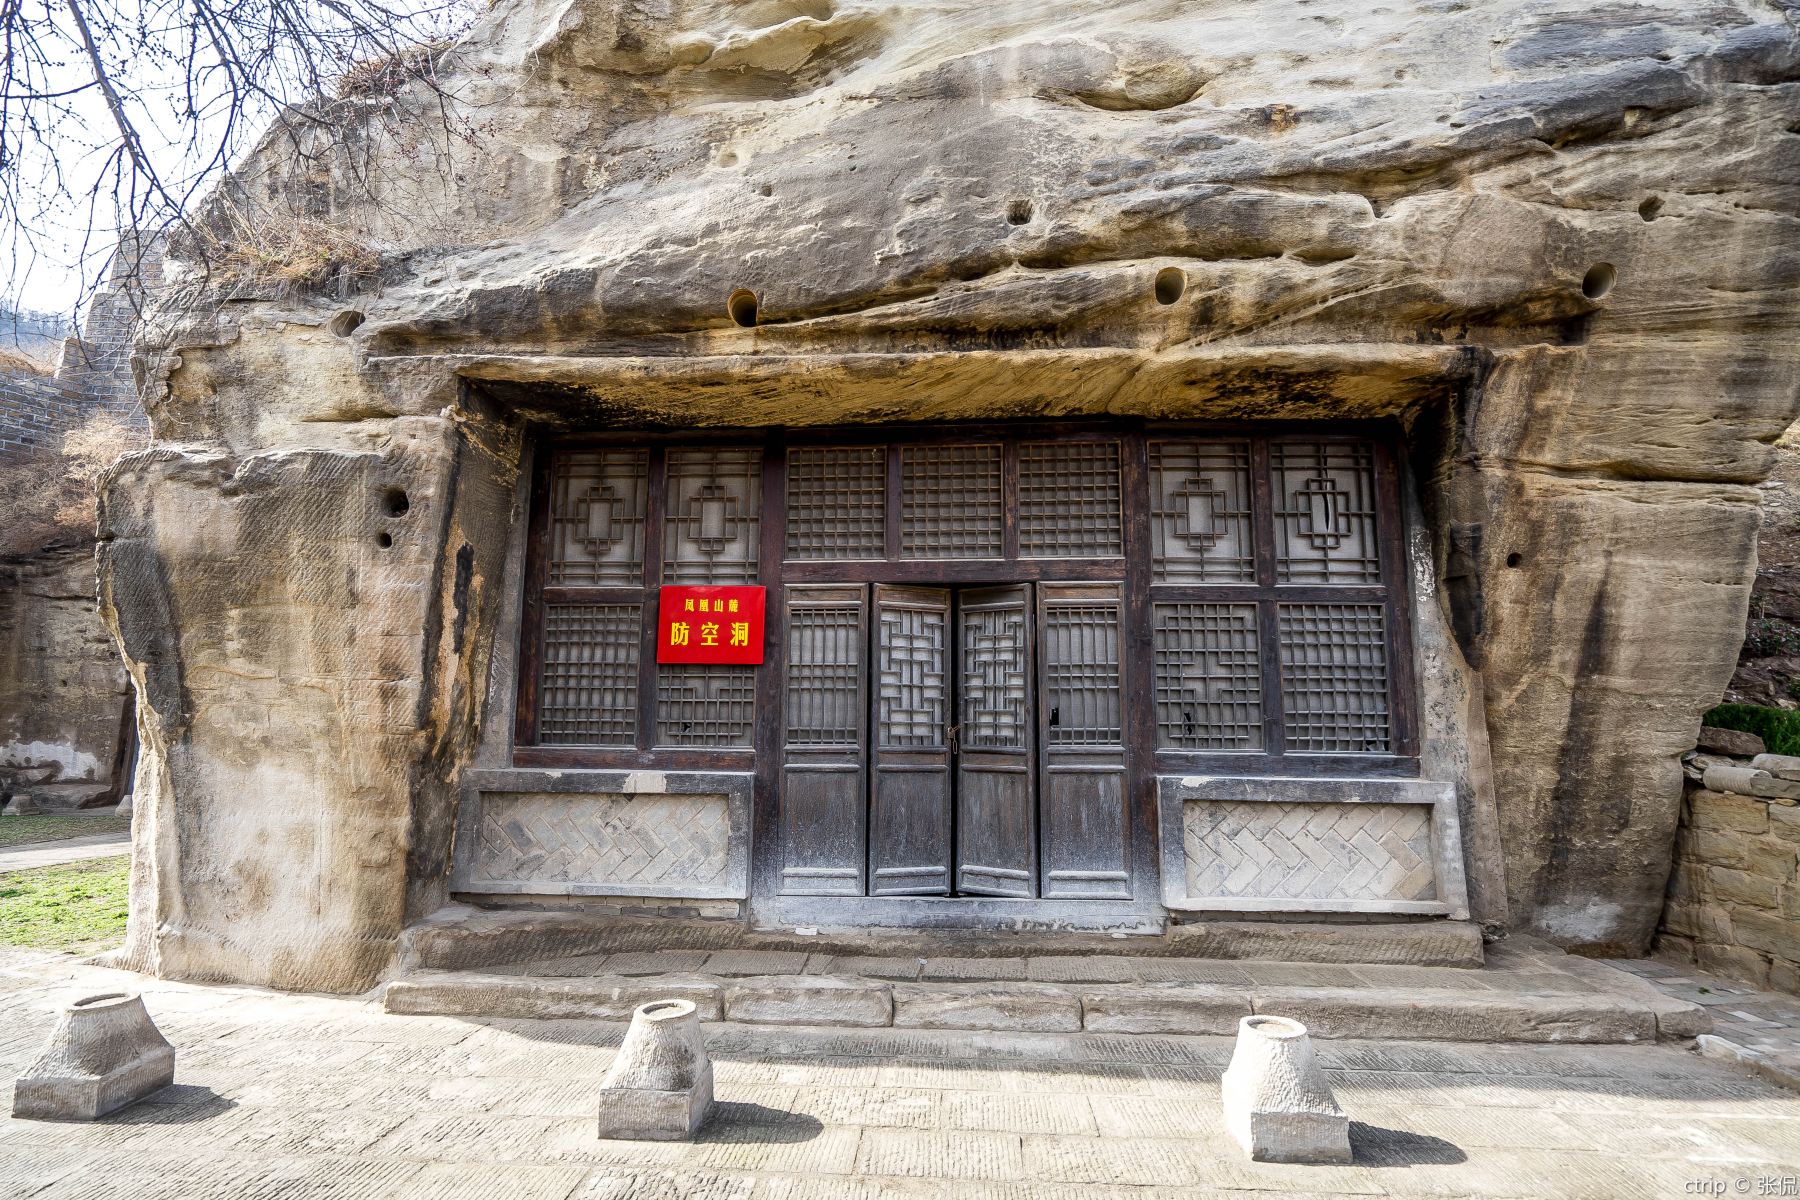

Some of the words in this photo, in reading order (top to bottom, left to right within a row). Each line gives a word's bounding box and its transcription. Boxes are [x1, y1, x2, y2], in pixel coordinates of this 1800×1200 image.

[685, 599, 739, 612] 凤凰山麓
[670, 622, 749, 646] 防空洞
